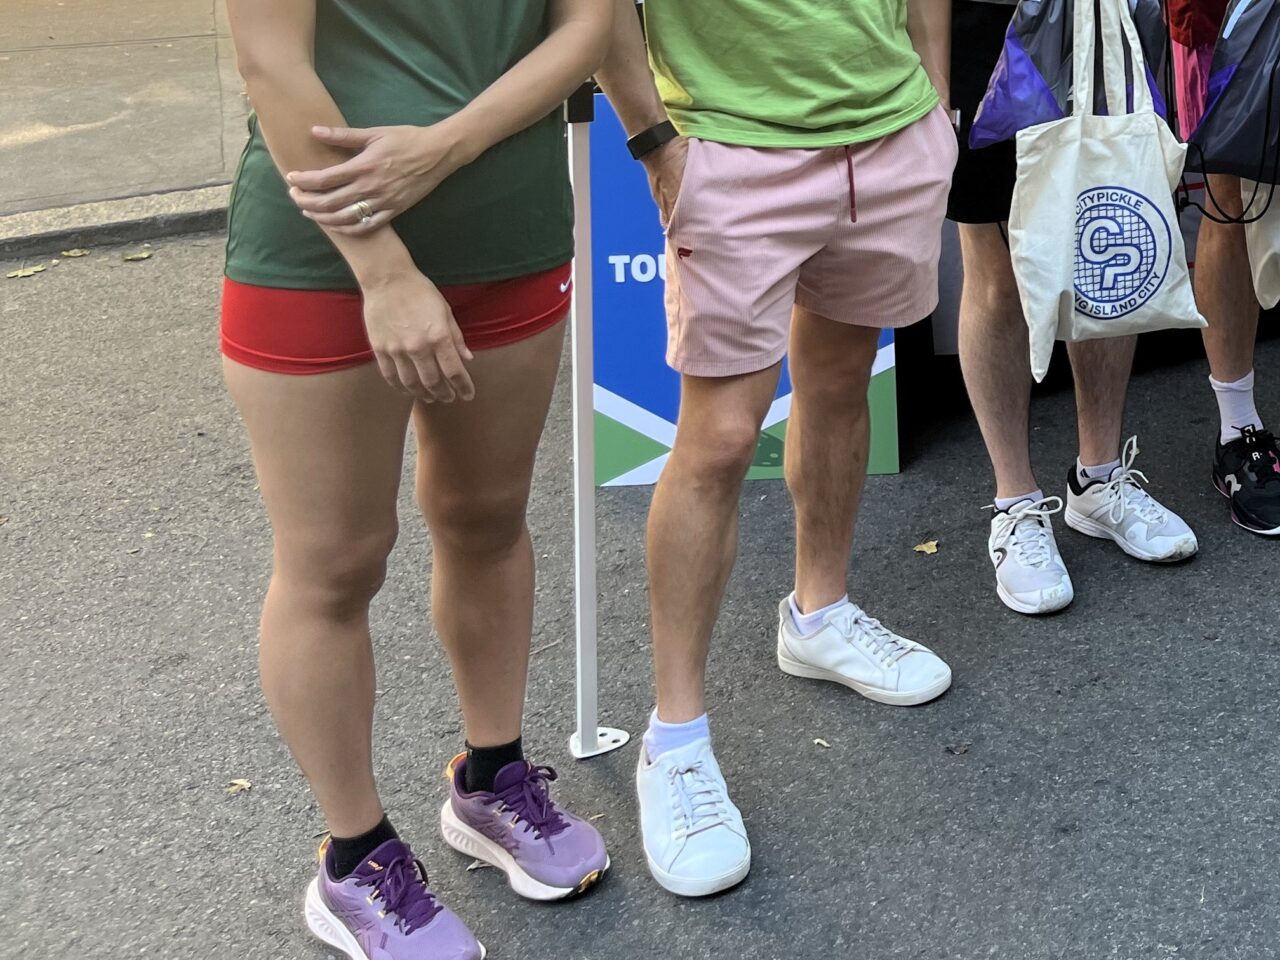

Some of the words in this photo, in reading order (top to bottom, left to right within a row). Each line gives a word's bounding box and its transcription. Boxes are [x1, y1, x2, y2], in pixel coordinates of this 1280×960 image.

[1075, 191, 1144, 216] CITYPICKLE
[1090, 297, 1137, 316] ISLAND
[1138, 271, 1161, 299] CITY
